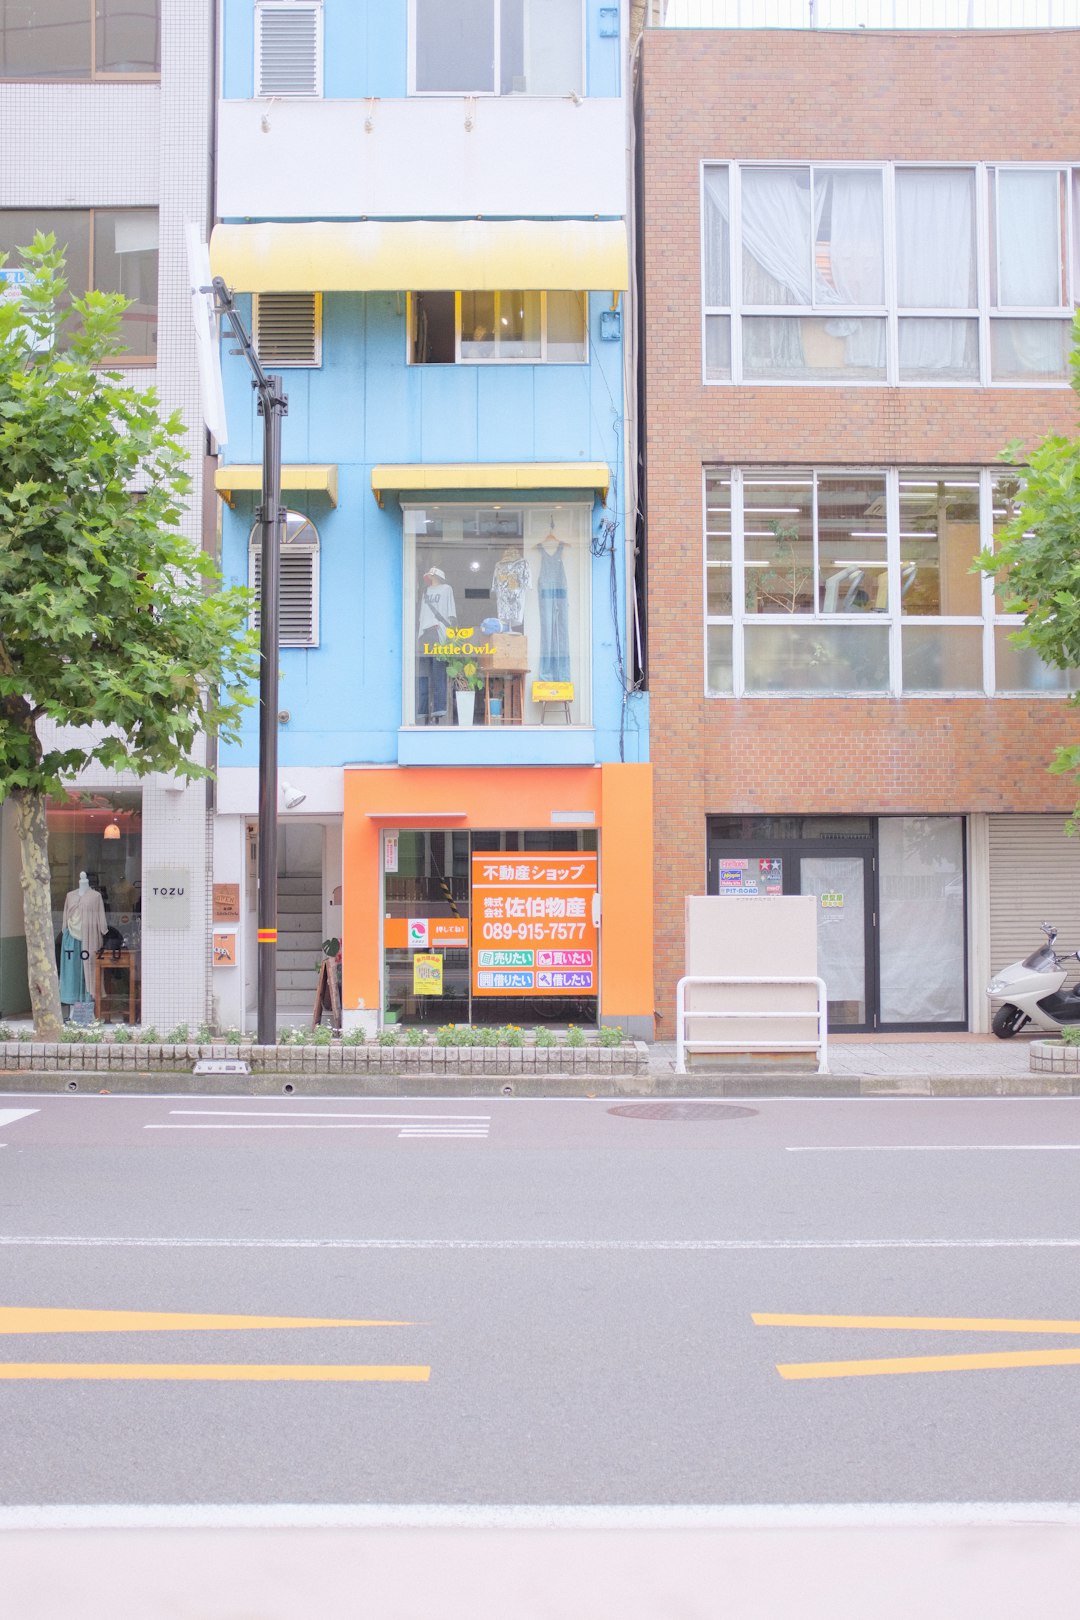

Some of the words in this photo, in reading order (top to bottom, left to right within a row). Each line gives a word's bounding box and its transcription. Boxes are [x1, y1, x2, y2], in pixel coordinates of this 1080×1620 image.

[483, 864, 585, 881] 不動産ショップ
[153, 887, 184, 896] TOZU
[216, 896, 235, 904] OPEN
[484, 897, 503, 907] 株式
[484, 908, 503, 918] 会社
[505, 897, 586, 918] 佐伯物産
[483, 922, 586, 940] 089-915-7577
[65, 949, 122, 960] TOZU
[494, 952, 532, 965] 売りたい
[553, 952, 591, 965] 買いたい
